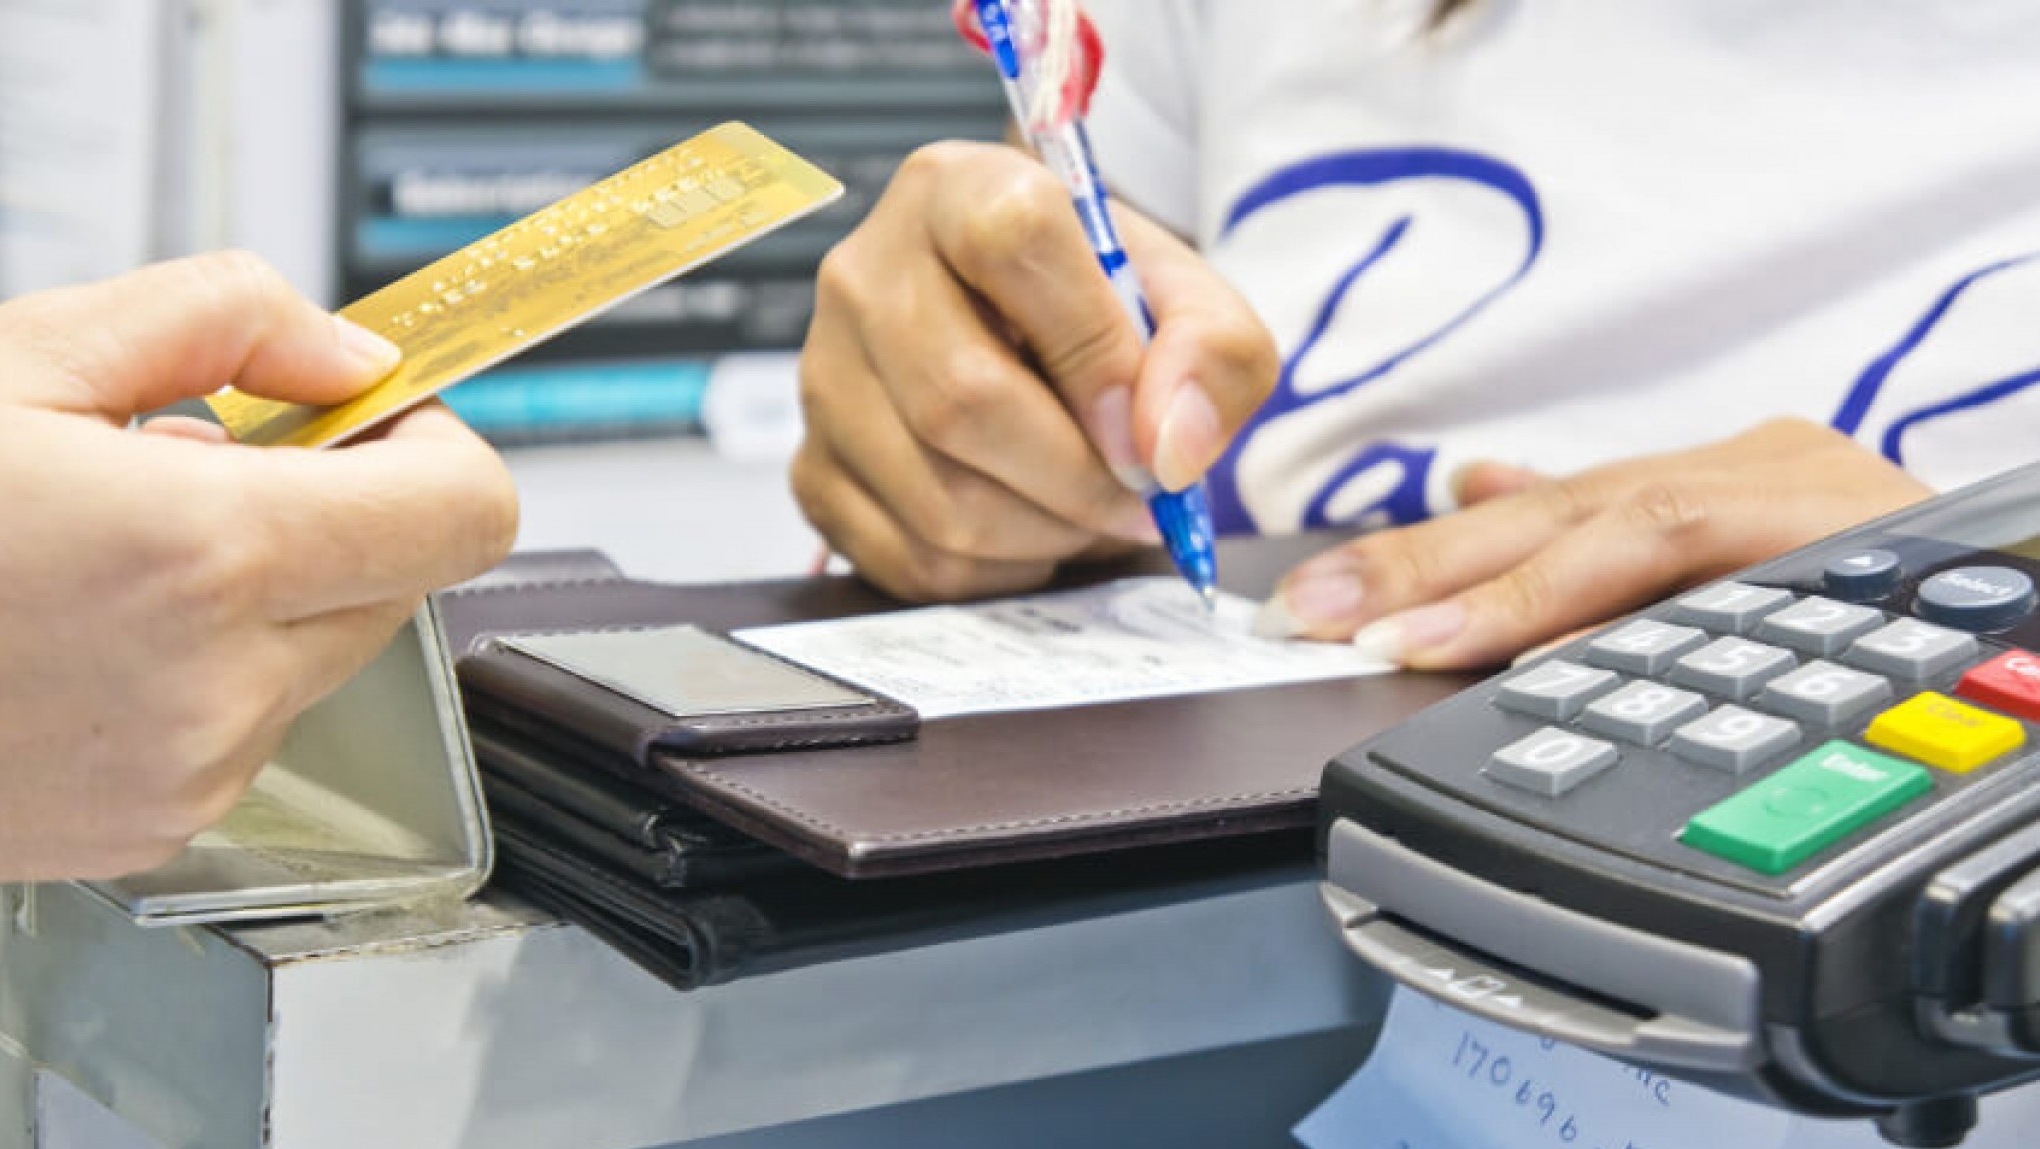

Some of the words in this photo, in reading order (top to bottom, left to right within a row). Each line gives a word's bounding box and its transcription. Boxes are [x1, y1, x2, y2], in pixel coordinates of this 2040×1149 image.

[1706, 588, 1752, 609] 1
[1786, 603, 1846, 630] 2
[1880, 625, 1942, 653] 3
[1618, 627, 1670, 650] 4
[1702, 645, 1768, 671] 5
[1793, 672, 1856, 698] 6
[1523, 668, 1590, 692] 7
[1611, 687, 1675, 716] 8
[1703, 715, 1764, 741] 9
[1523, 739, 1582, 765] 0
